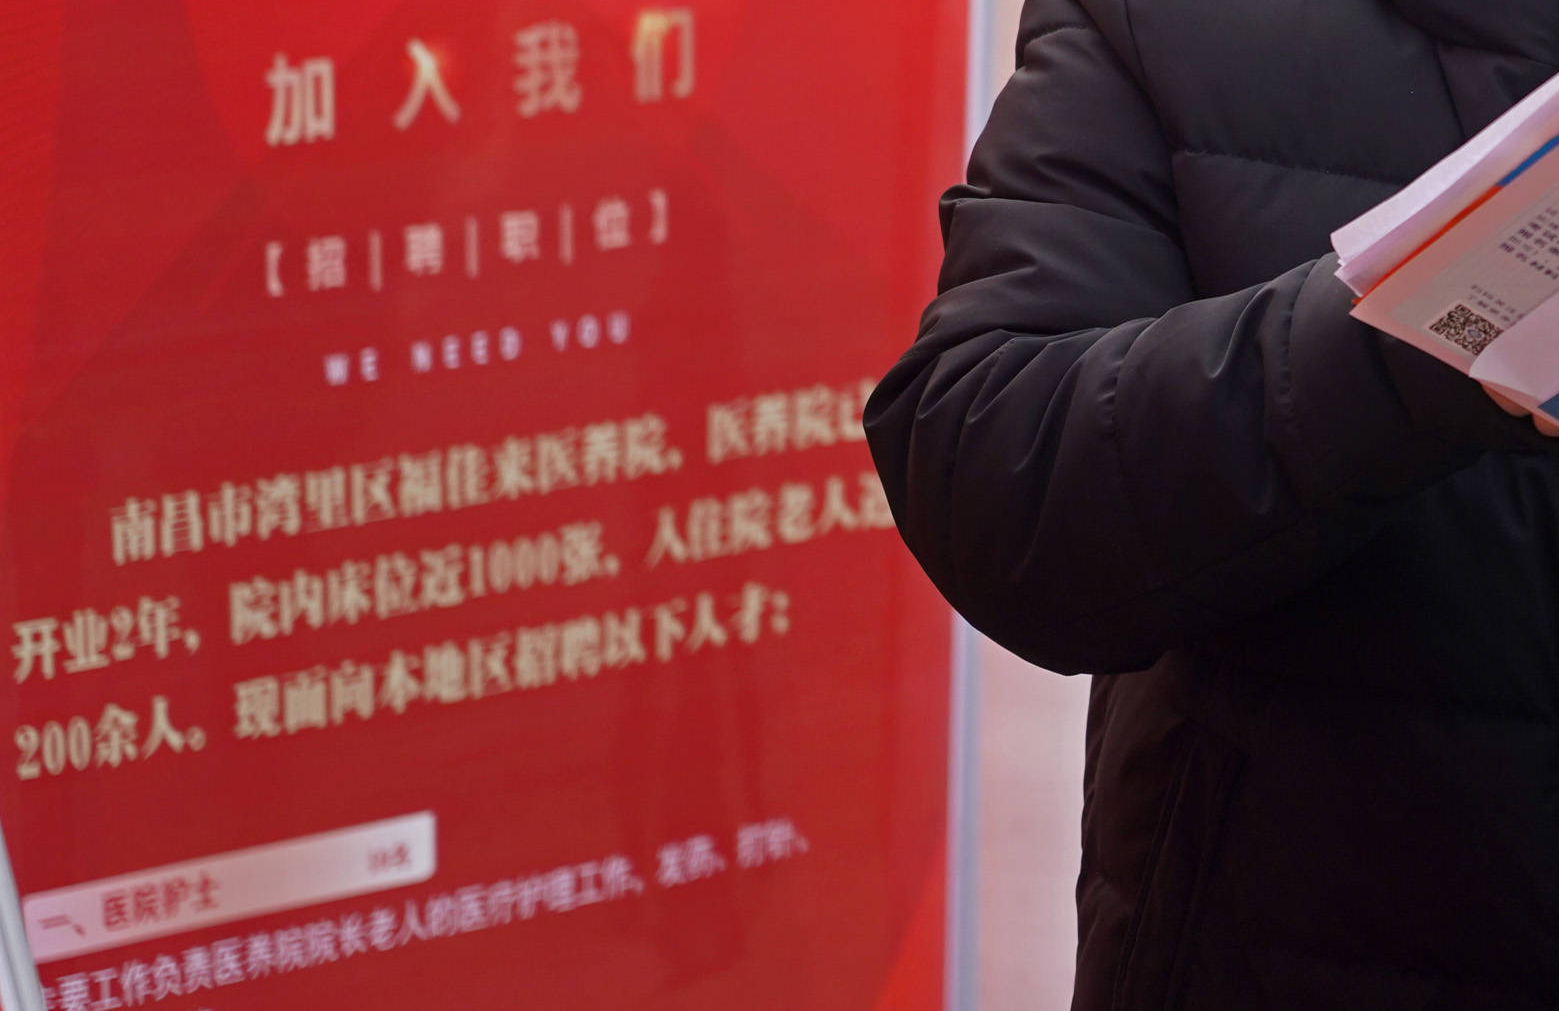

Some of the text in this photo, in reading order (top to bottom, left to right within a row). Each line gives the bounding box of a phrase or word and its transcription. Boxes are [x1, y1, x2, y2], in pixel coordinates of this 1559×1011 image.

[264, 9, 695, 147] 加入我们
[324, 309, 632, 386] WE NEED YOU
